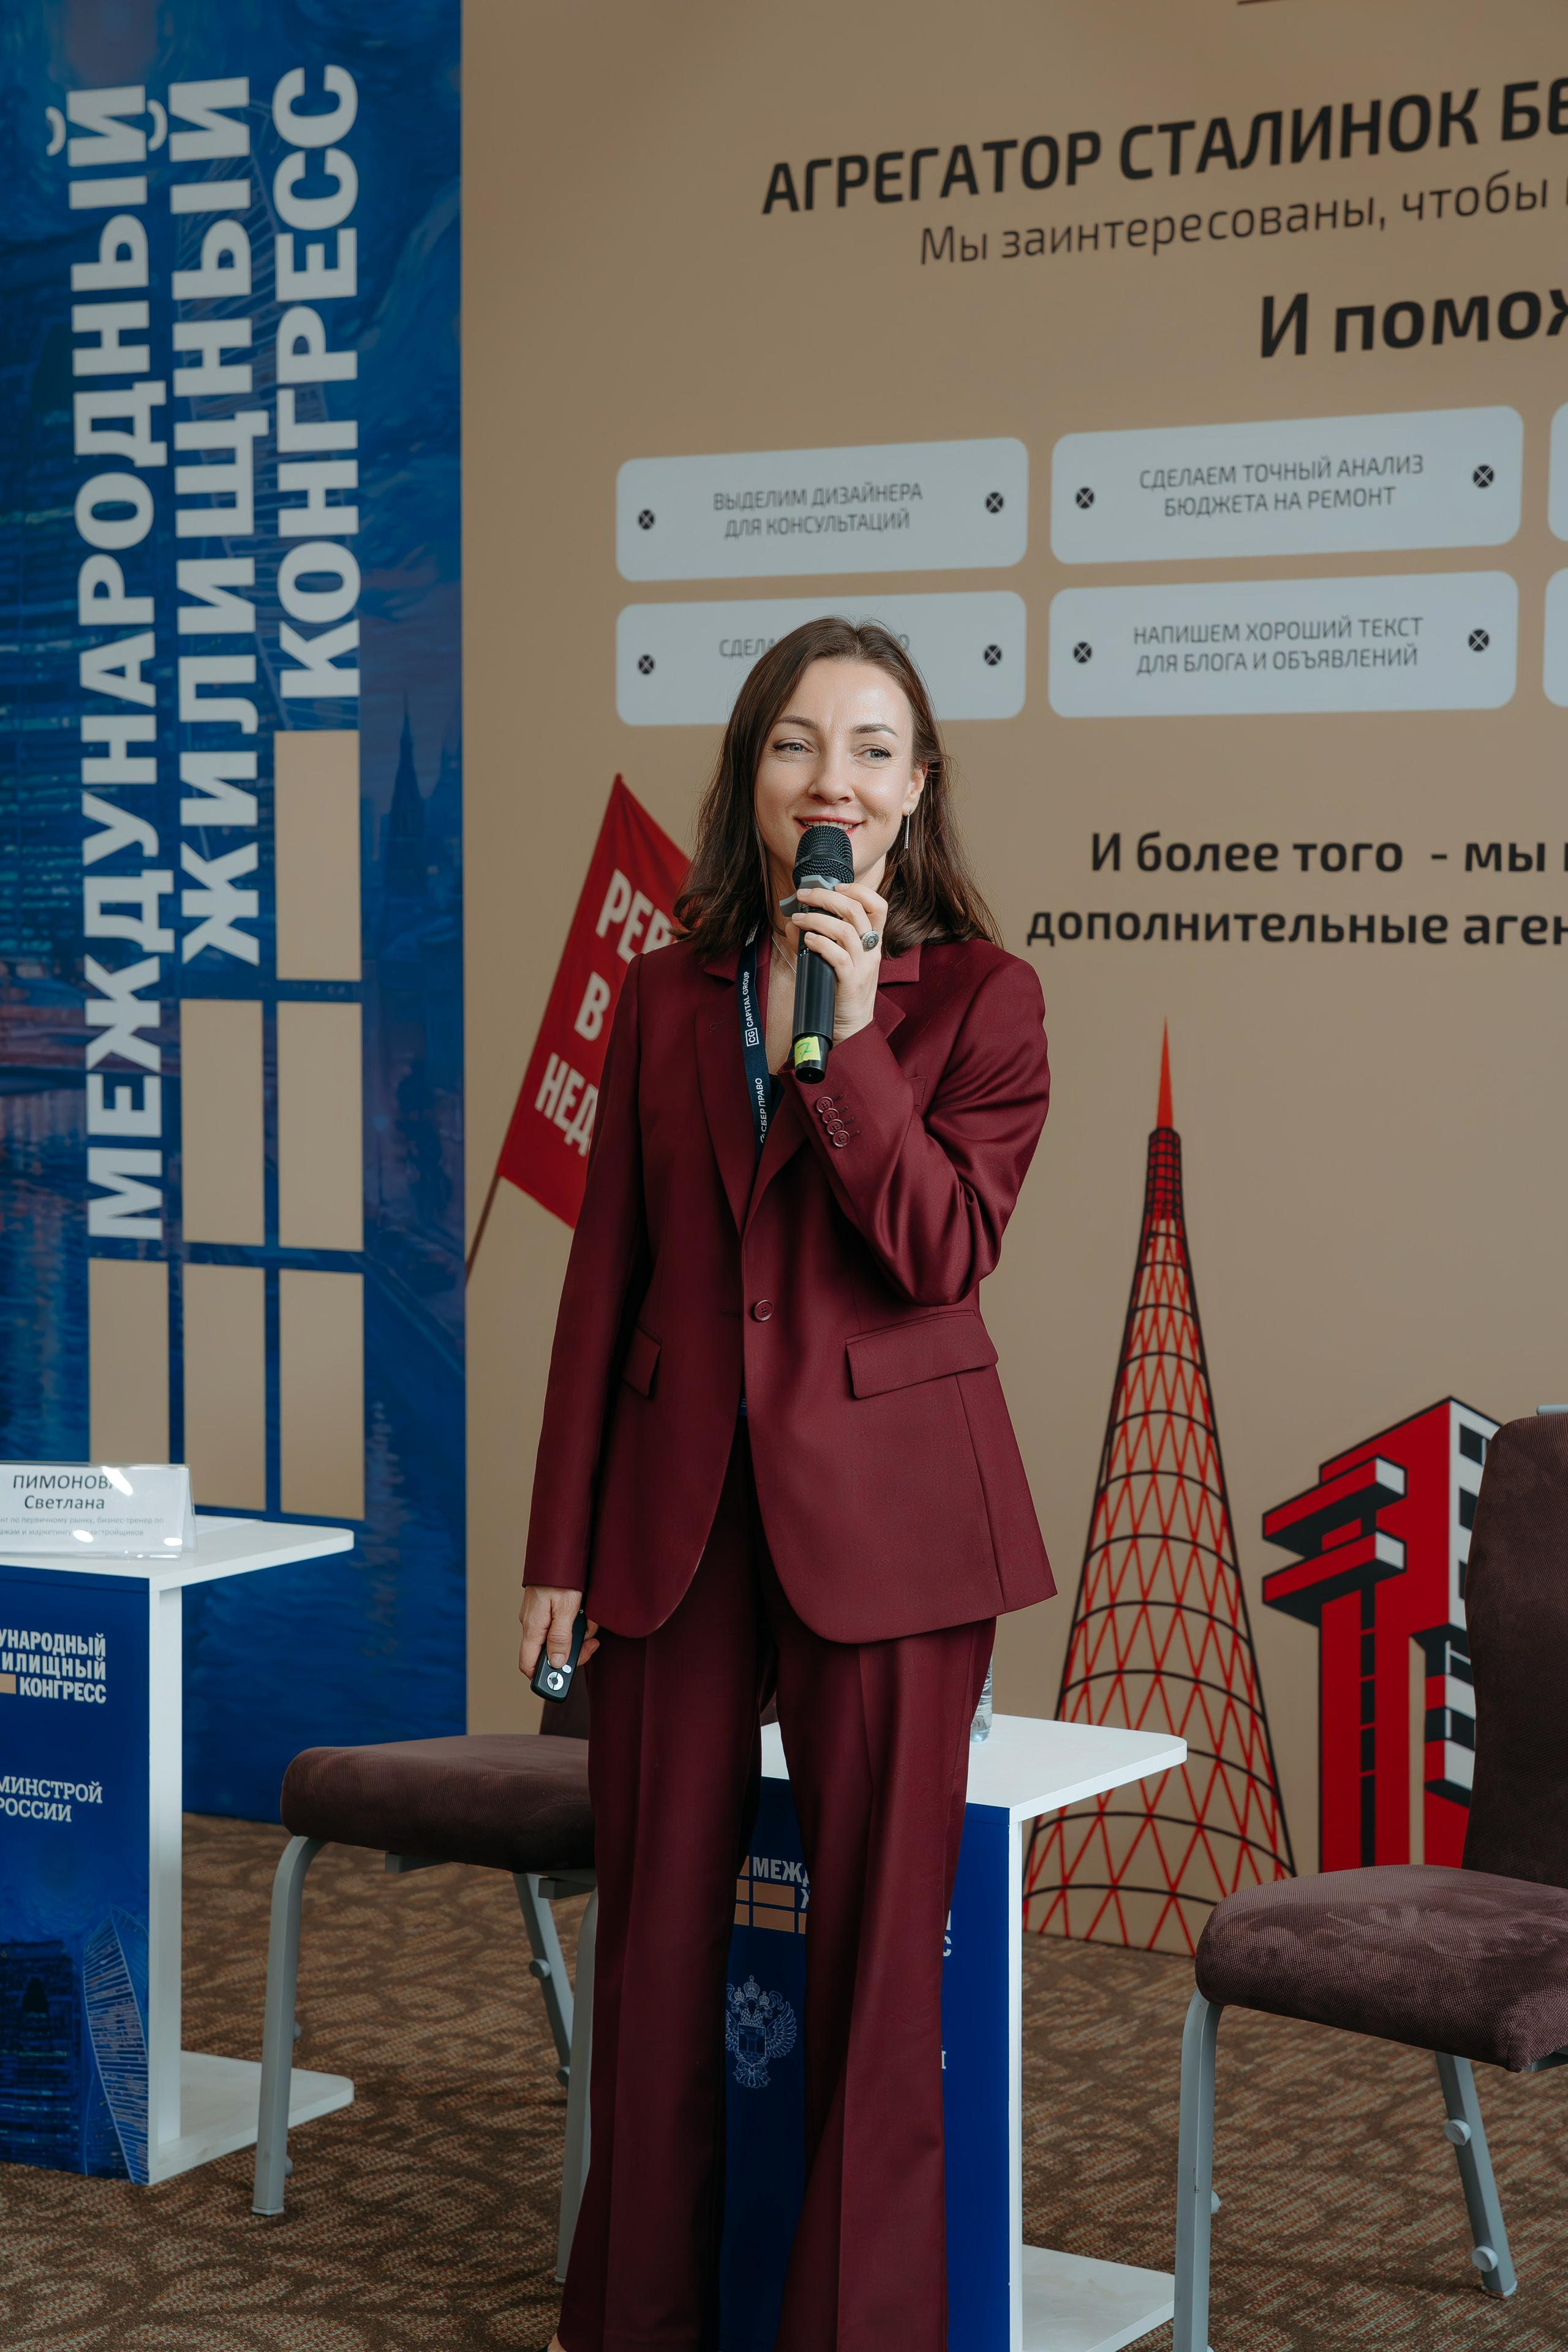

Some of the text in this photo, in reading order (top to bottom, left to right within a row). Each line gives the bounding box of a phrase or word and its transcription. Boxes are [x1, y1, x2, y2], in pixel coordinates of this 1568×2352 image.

[762, 130, 1101, 214] АГРЕГАТОР
[1120, 88, 1479, 180] СТАЛИНОК
[921, 226, 987, 265] Мы
[1001, 195, 1385, 259] заинтересованы,
[1402, 170, 1548, 221] чтобы
[1261, 293, 1309, 358] И
[271, 64, 361, 698] КОНГРЕСС
[1139, 454, 1424, 491] СДЕЛАЕМ ТОЧНЫЙ АНАЛИЗ
[713, 481, 923, 511] ВЫДЕЛИМ ДИЗАЙНЕРА
[1164, 486, 1396, 518] БЮДЖЕТА НА РЕМОНТ
[147, 76, 270, 966] ЖИЛИЩНЫЙ
[723, 508, 910, 540] ДЛЯ КОНСУЛЬТАЦИЙ
[1134, 615, 1424, 645] НАПИШЕМ ХОРОШИЙ ТЕКСТ
[46, 85, 174, 1240] МЕЖДУНАРОДНЫЙ
[1136, 643, 1418, 676] ДЛЯ БЛОГА И ОБЪЯВЛЕНИЙ
[1091, 832, 1121, 872] И
[1137, 831, 1279, 872] более
[1292, 842, 1403, 872] того
[1464, 842, 1545, 872] мы
[1027, 911, 1449, 947] дополнительные
[574, 971, 611, 1041] В
[744, 995, 753, 1027] CAPITAL
[748, 1030, 756, 1043] CG
[755, 1078, 766, 1107] ПРАВО
[13, 1475, 113, 1489] ПИМОНОВ
[24, 1494, 105, 1509] Светлана
[0, 1651, 106, 1681] ИЛИЩНЫЙ
[20, 1676, 107, 1704] КОНГРЕСС
[0, 1776, 103, 1803] МИНСТРОЙ
